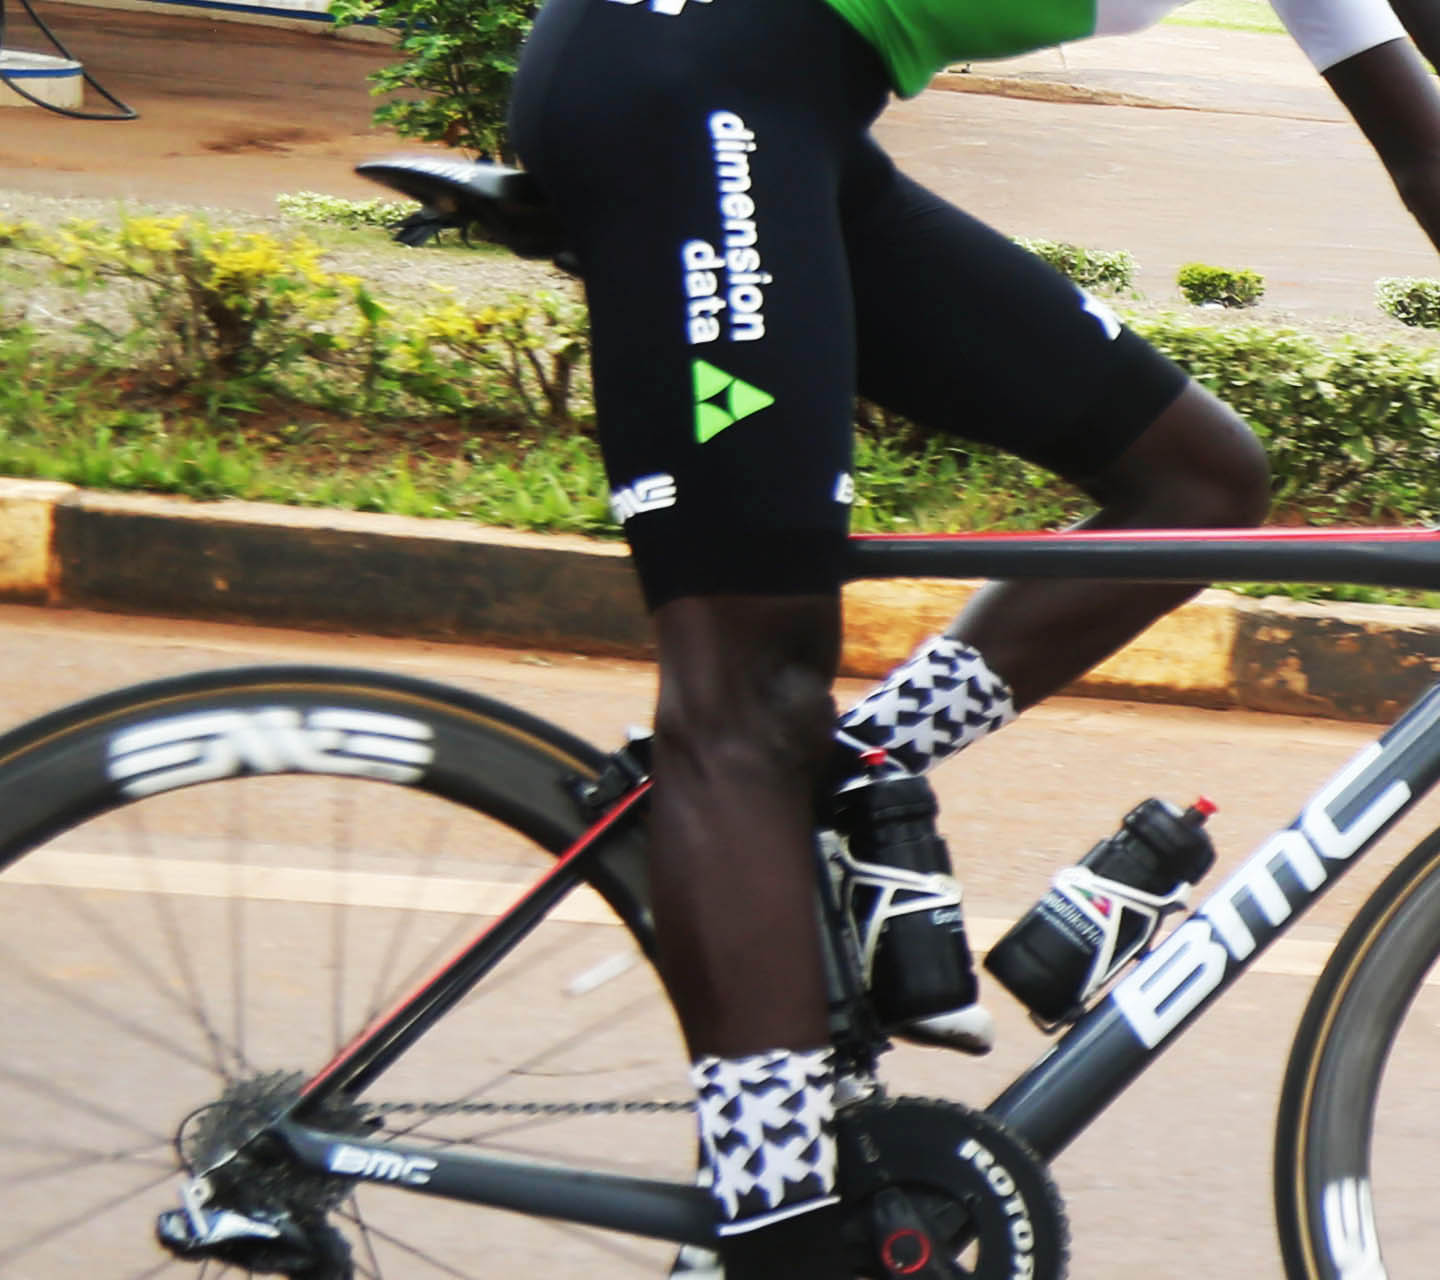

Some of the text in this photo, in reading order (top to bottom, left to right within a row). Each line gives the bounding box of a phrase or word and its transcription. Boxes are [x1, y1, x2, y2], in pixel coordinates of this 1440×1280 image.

[680, 238, 727, 345] data
[708, 108, 773, 343] dimension
[1110, 740, 1412, 1051] BMC
[329, 1143, 439, 1186] BMC
